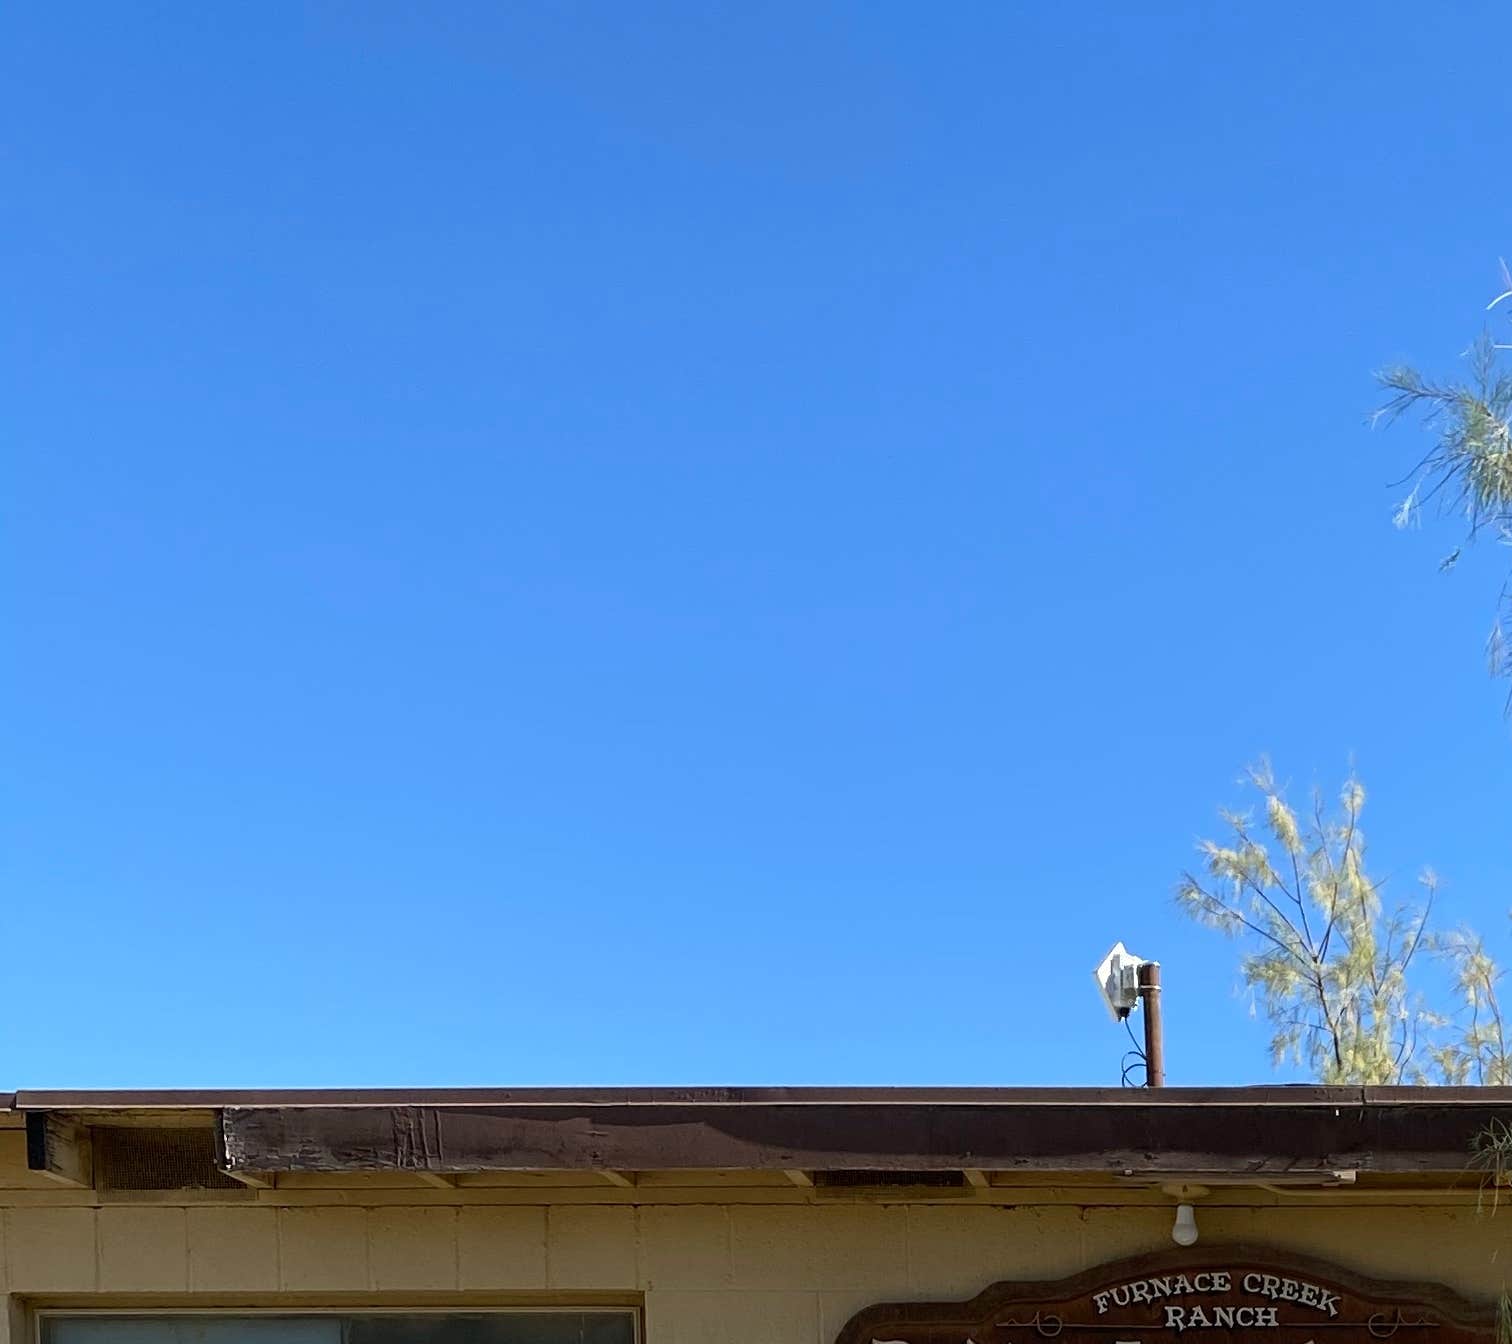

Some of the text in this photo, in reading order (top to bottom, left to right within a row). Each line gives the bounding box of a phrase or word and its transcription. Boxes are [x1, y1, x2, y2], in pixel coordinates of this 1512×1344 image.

[1093, 1272, 1341, 1316] FURNACE CREEK
[1164, 1307, 1280, 1330] RANCH
